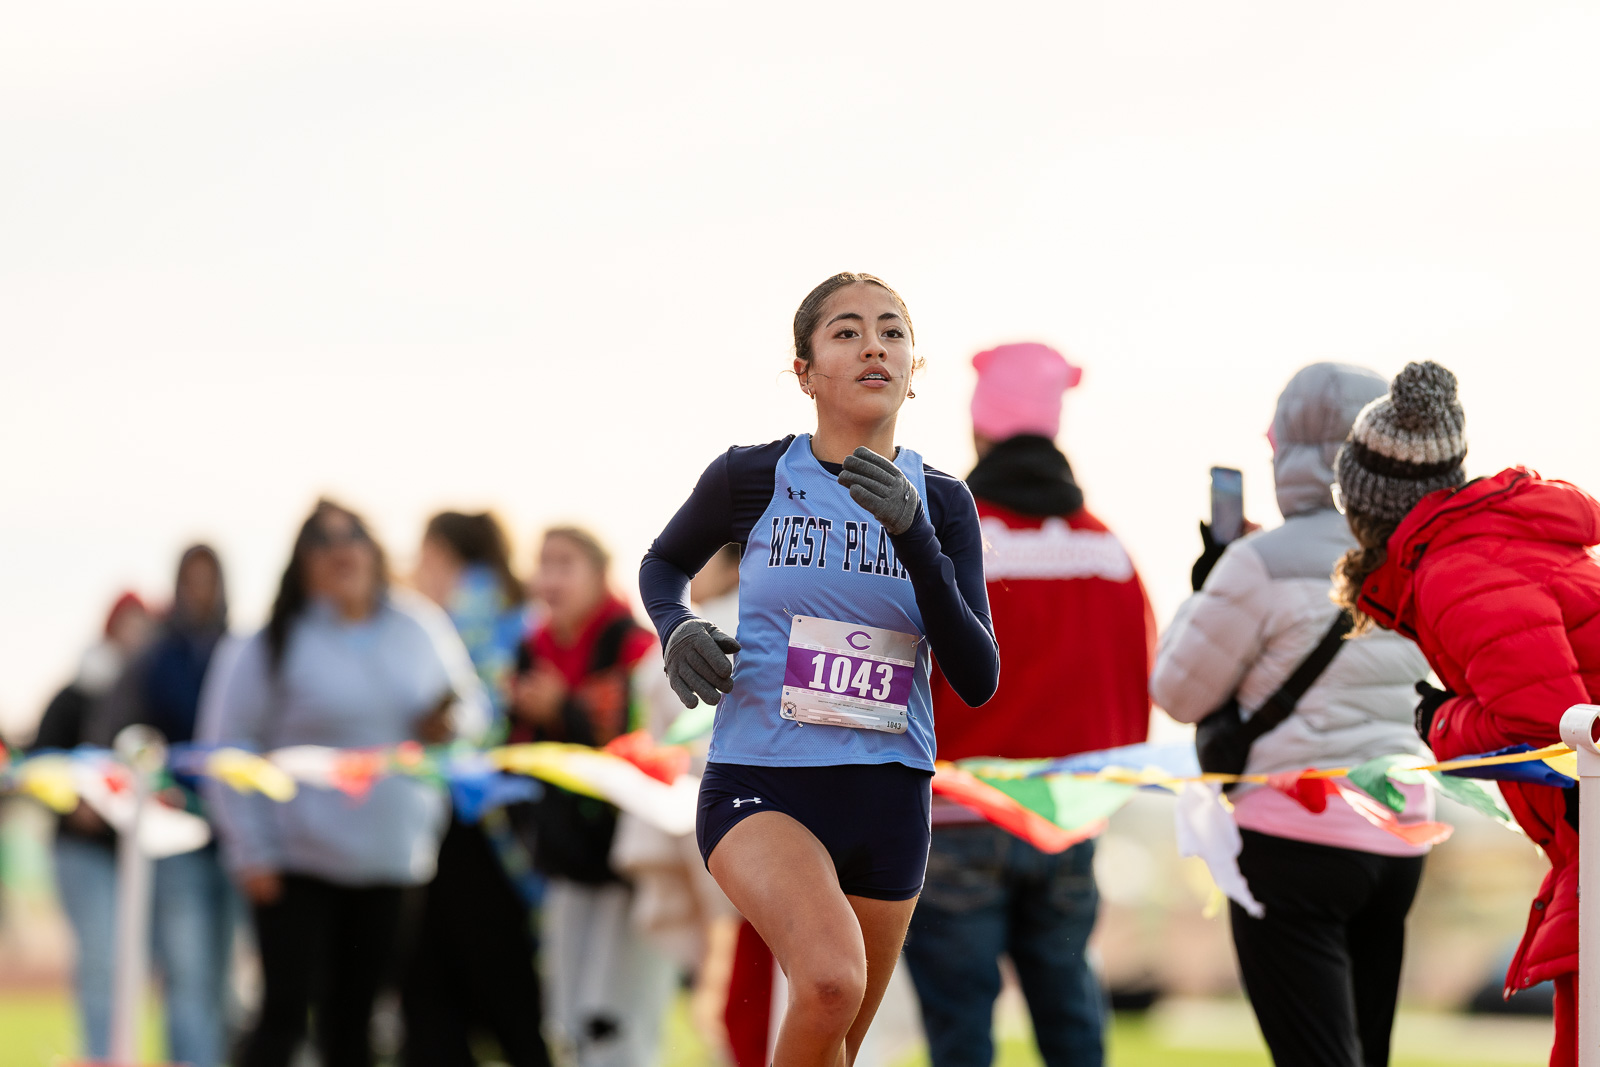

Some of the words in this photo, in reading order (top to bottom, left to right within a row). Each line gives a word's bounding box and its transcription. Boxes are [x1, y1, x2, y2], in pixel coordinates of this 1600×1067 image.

[768, 516, 833, 569] WEST
[845, 630, 872, 651] C
[808, 653, 894, 701] 1043
[886, 720, 902, 730] 1043
